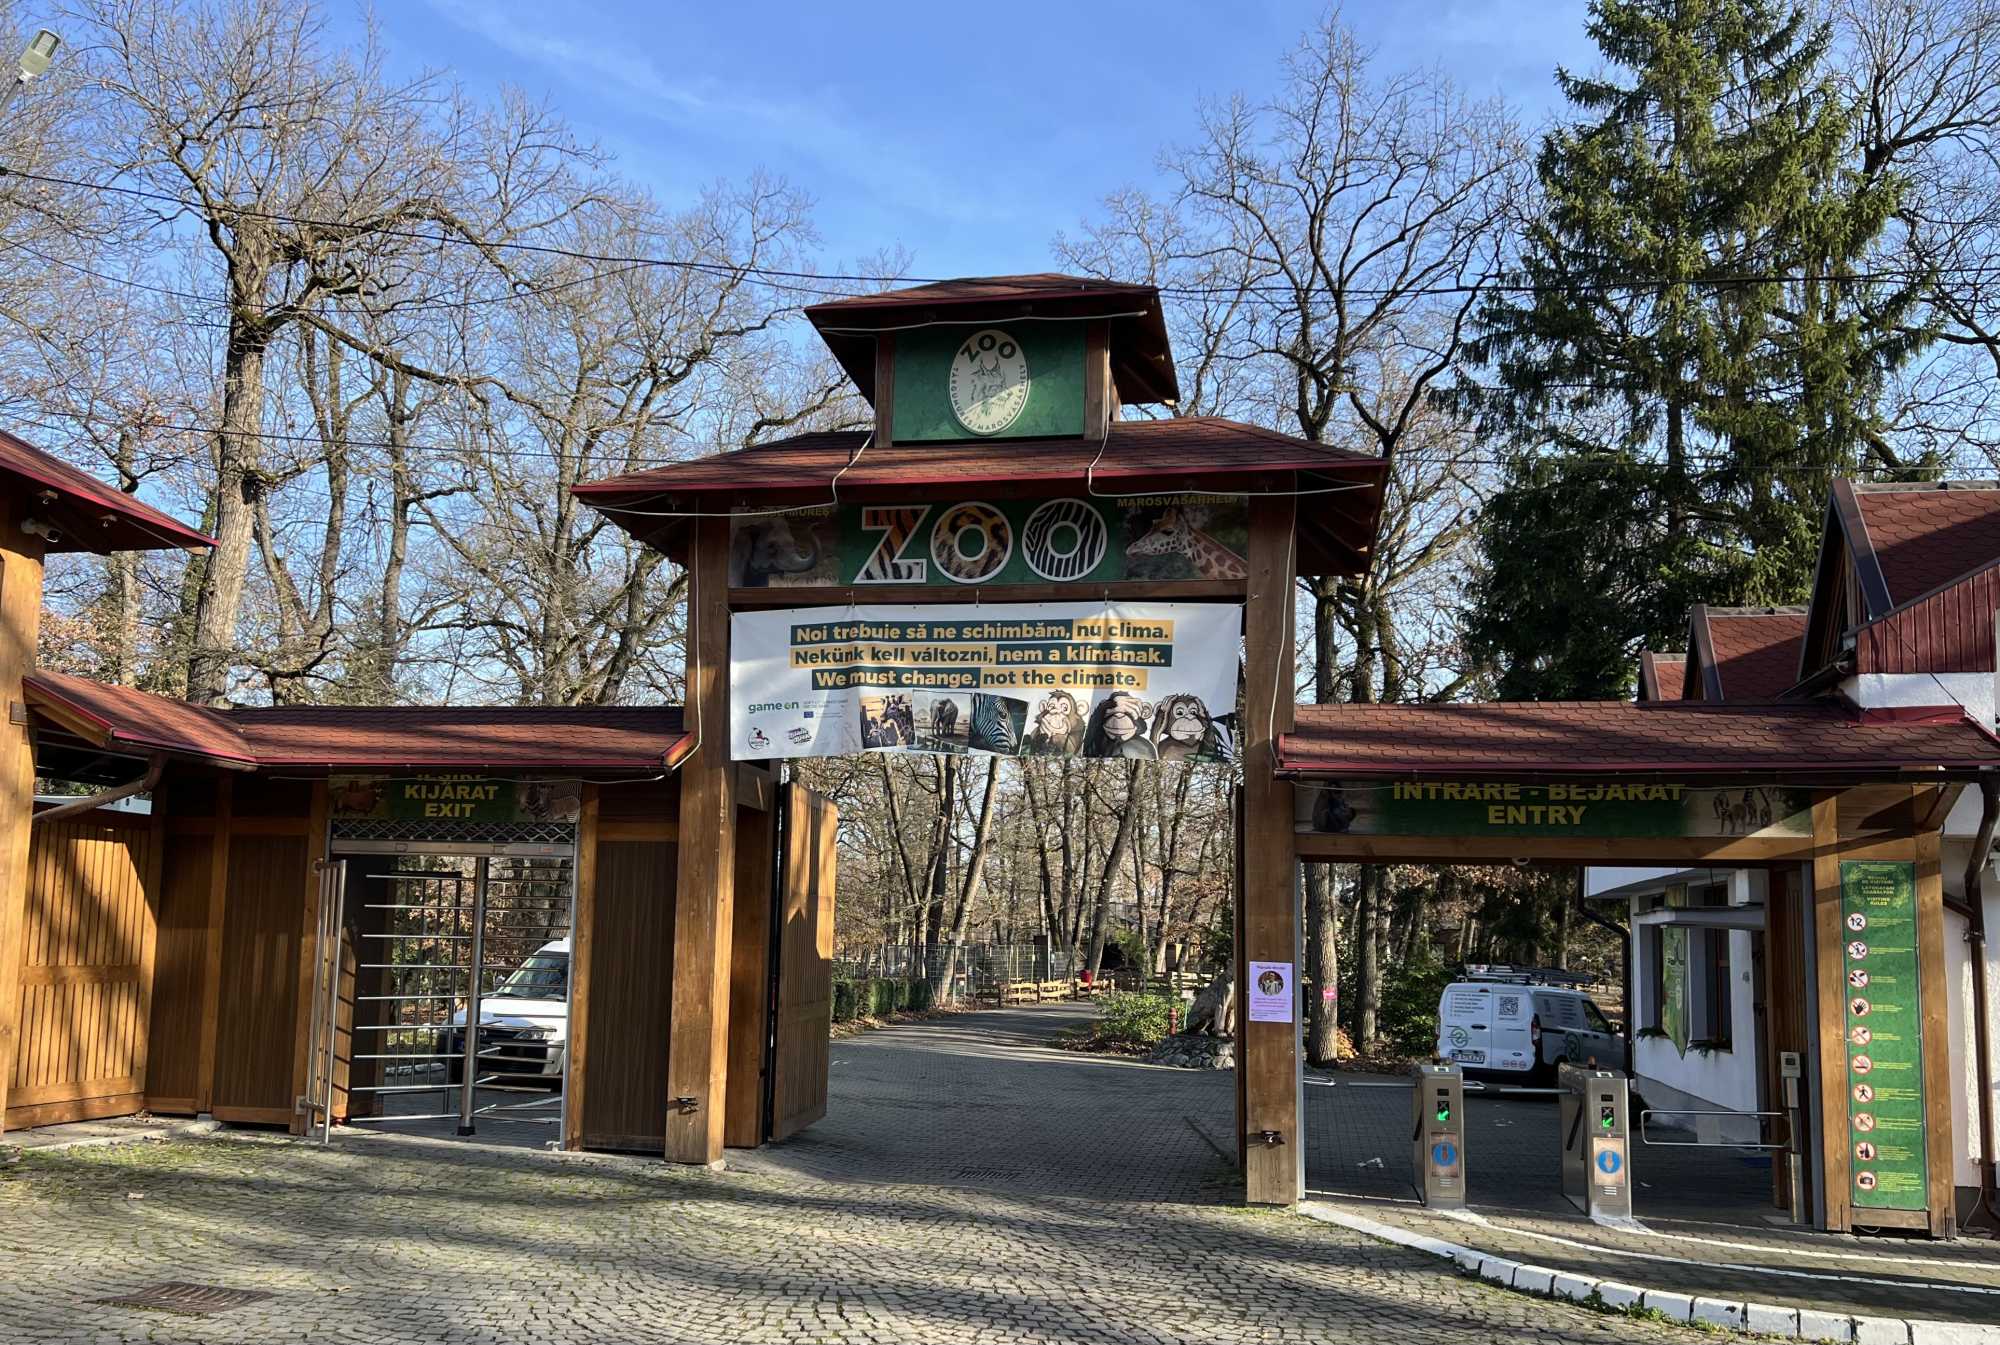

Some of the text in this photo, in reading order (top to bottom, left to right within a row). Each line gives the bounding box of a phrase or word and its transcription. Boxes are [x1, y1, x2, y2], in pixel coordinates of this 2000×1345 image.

[960, 334, 1016, 362] ZOO
[853, 498, 1107, 584] ZOO
[796, 621, 1169, 642] Noi trebuie să ne schimbăm, nu clima.
[795, 643, 1165, 665] Nekünk kell változni, nem a klímának.
[815, 669, 1140, 688] We must change, not the climate.
[404, 781, 499, 800] KIJÁRAT
[1393, 782, 1521, 800] INTRARE
[425, 802, 475, 817] EXIT
[1488, 805, 1587, 825] ENTRY
